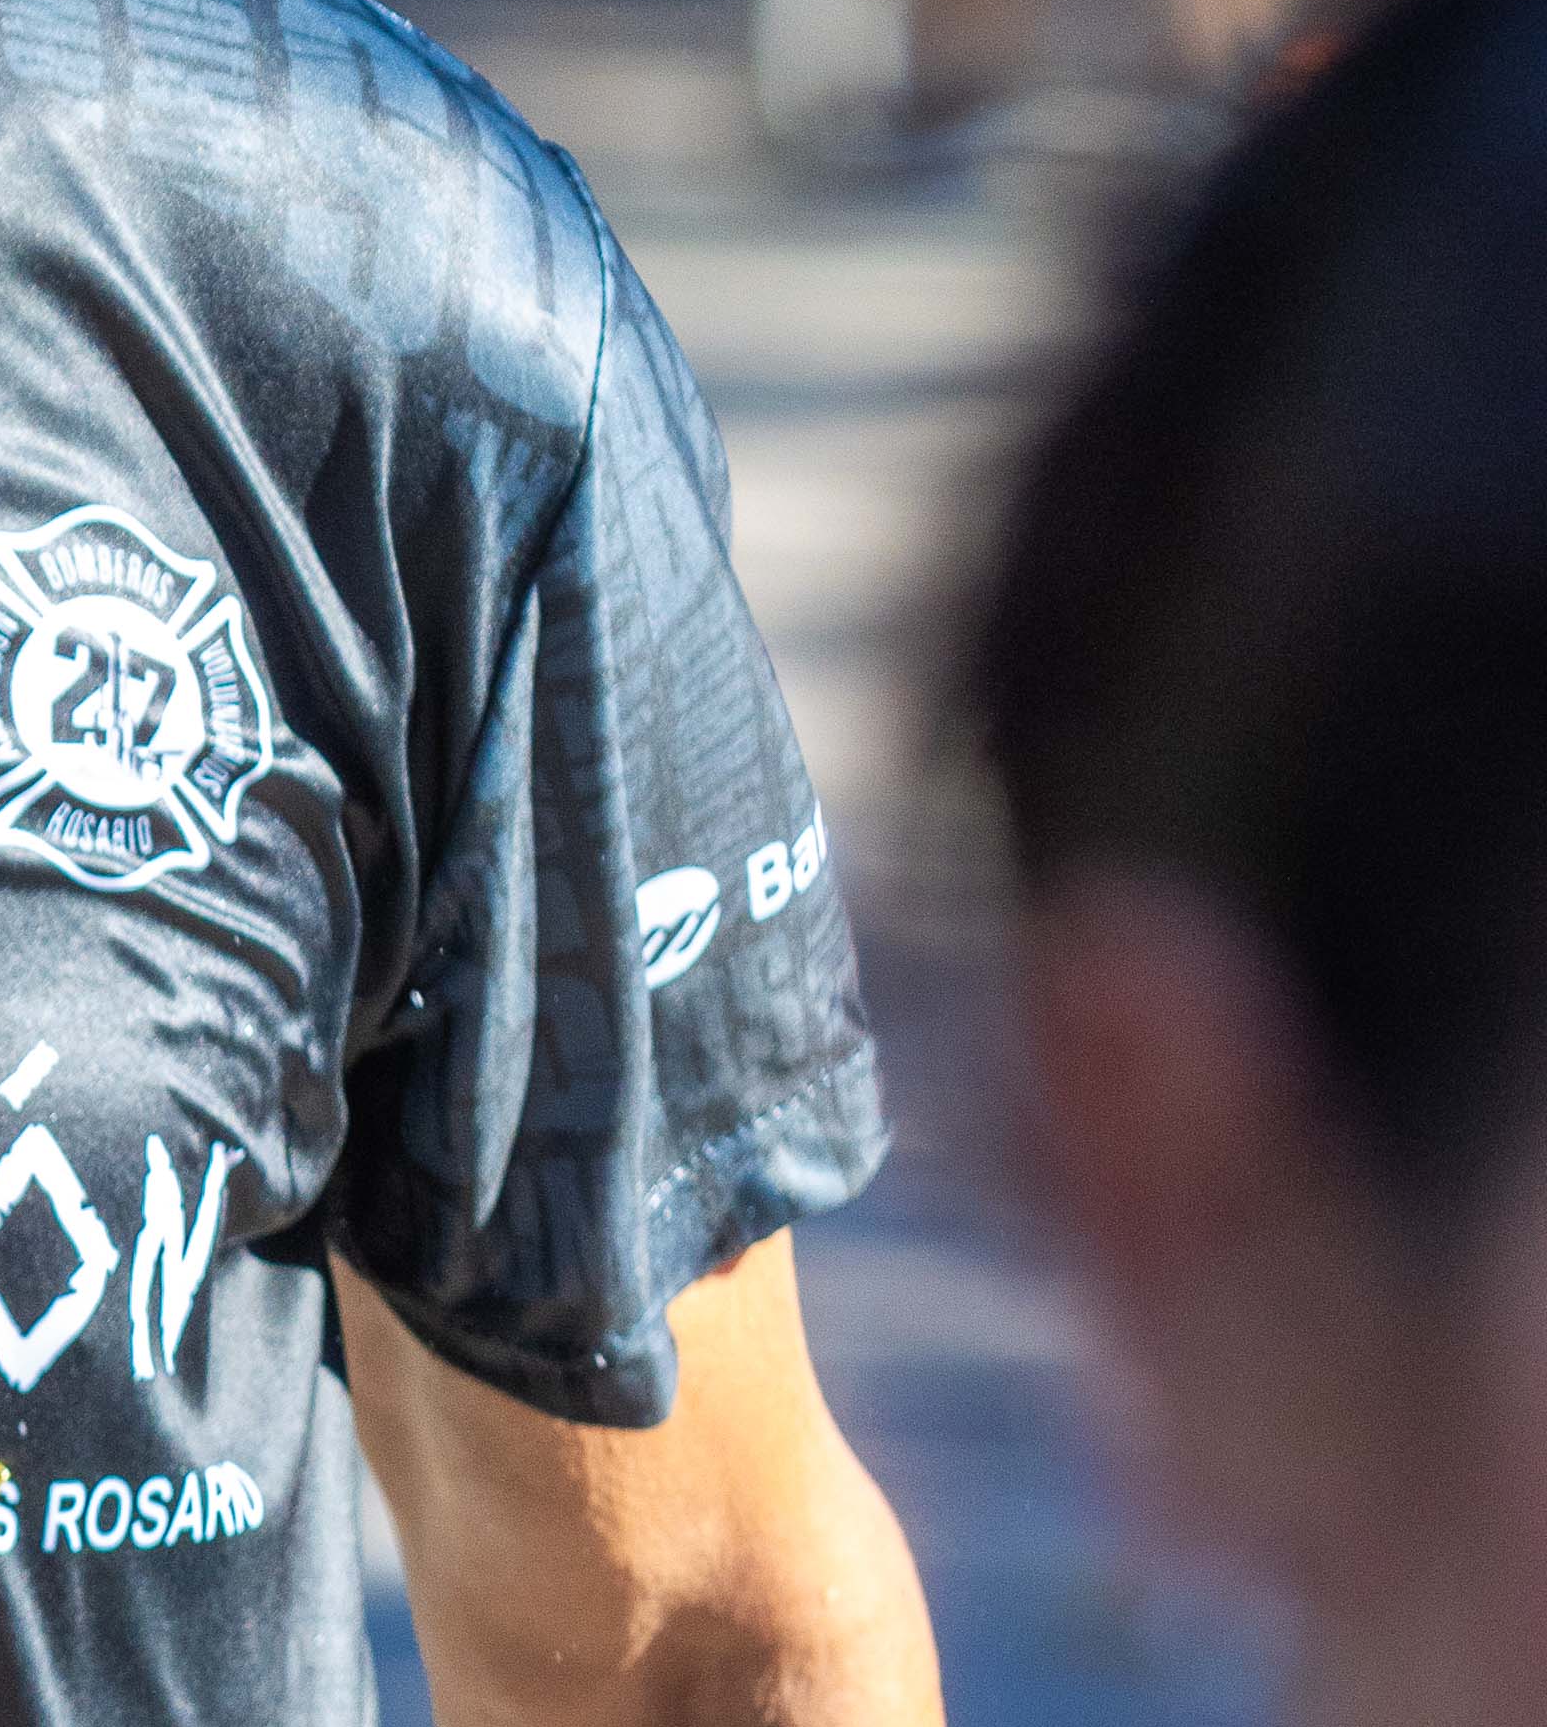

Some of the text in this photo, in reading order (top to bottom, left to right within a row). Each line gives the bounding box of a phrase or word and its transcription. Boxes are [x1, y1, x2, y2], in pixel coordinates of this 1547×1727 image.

[38, 543, 175, 609] BOMBEROS
[51, 626, 177, 747] 27
[44, 801, 154, 856] ROSARIO
